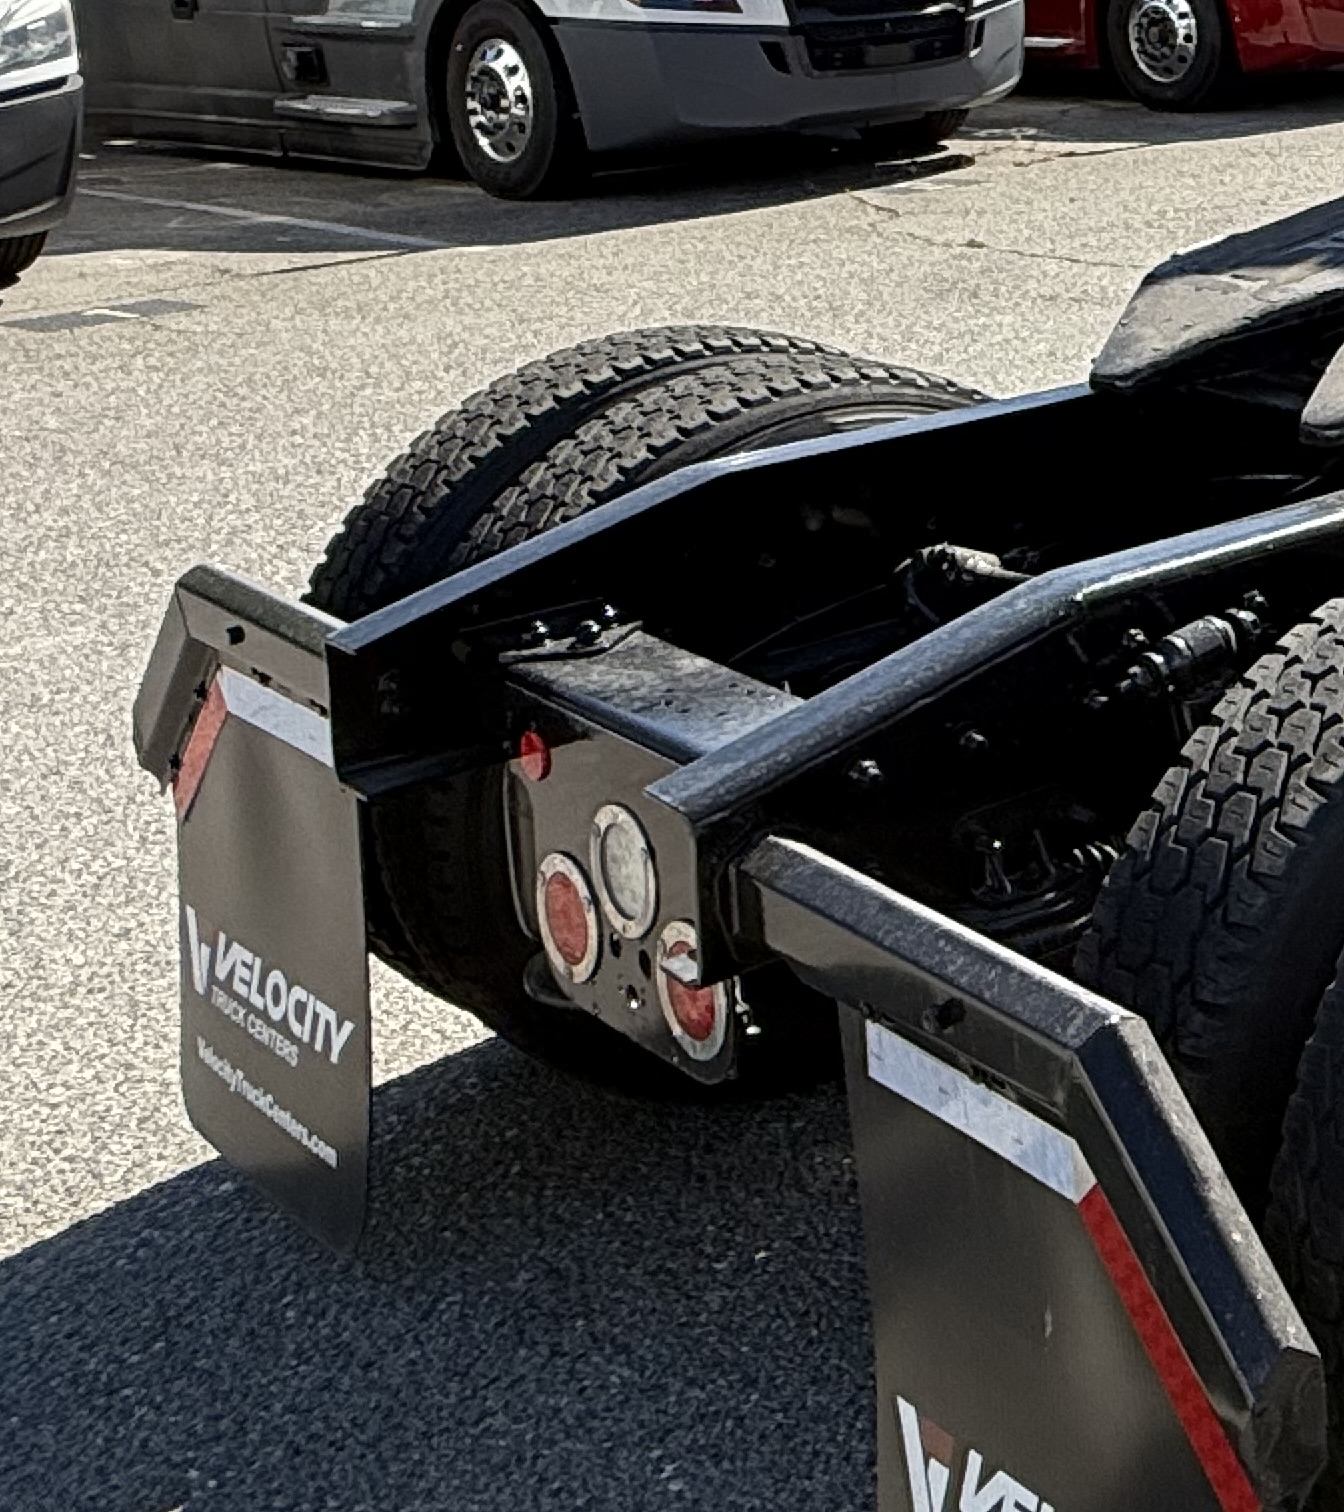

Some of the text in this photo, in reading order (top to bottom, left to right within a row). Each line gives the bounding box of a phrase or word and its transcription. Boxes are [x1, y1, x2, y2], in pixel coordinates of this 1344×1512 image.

[210, 986, 300, 1068] TRUCK CENTERS
[214, 930, 356, 1065] VELOCITY
